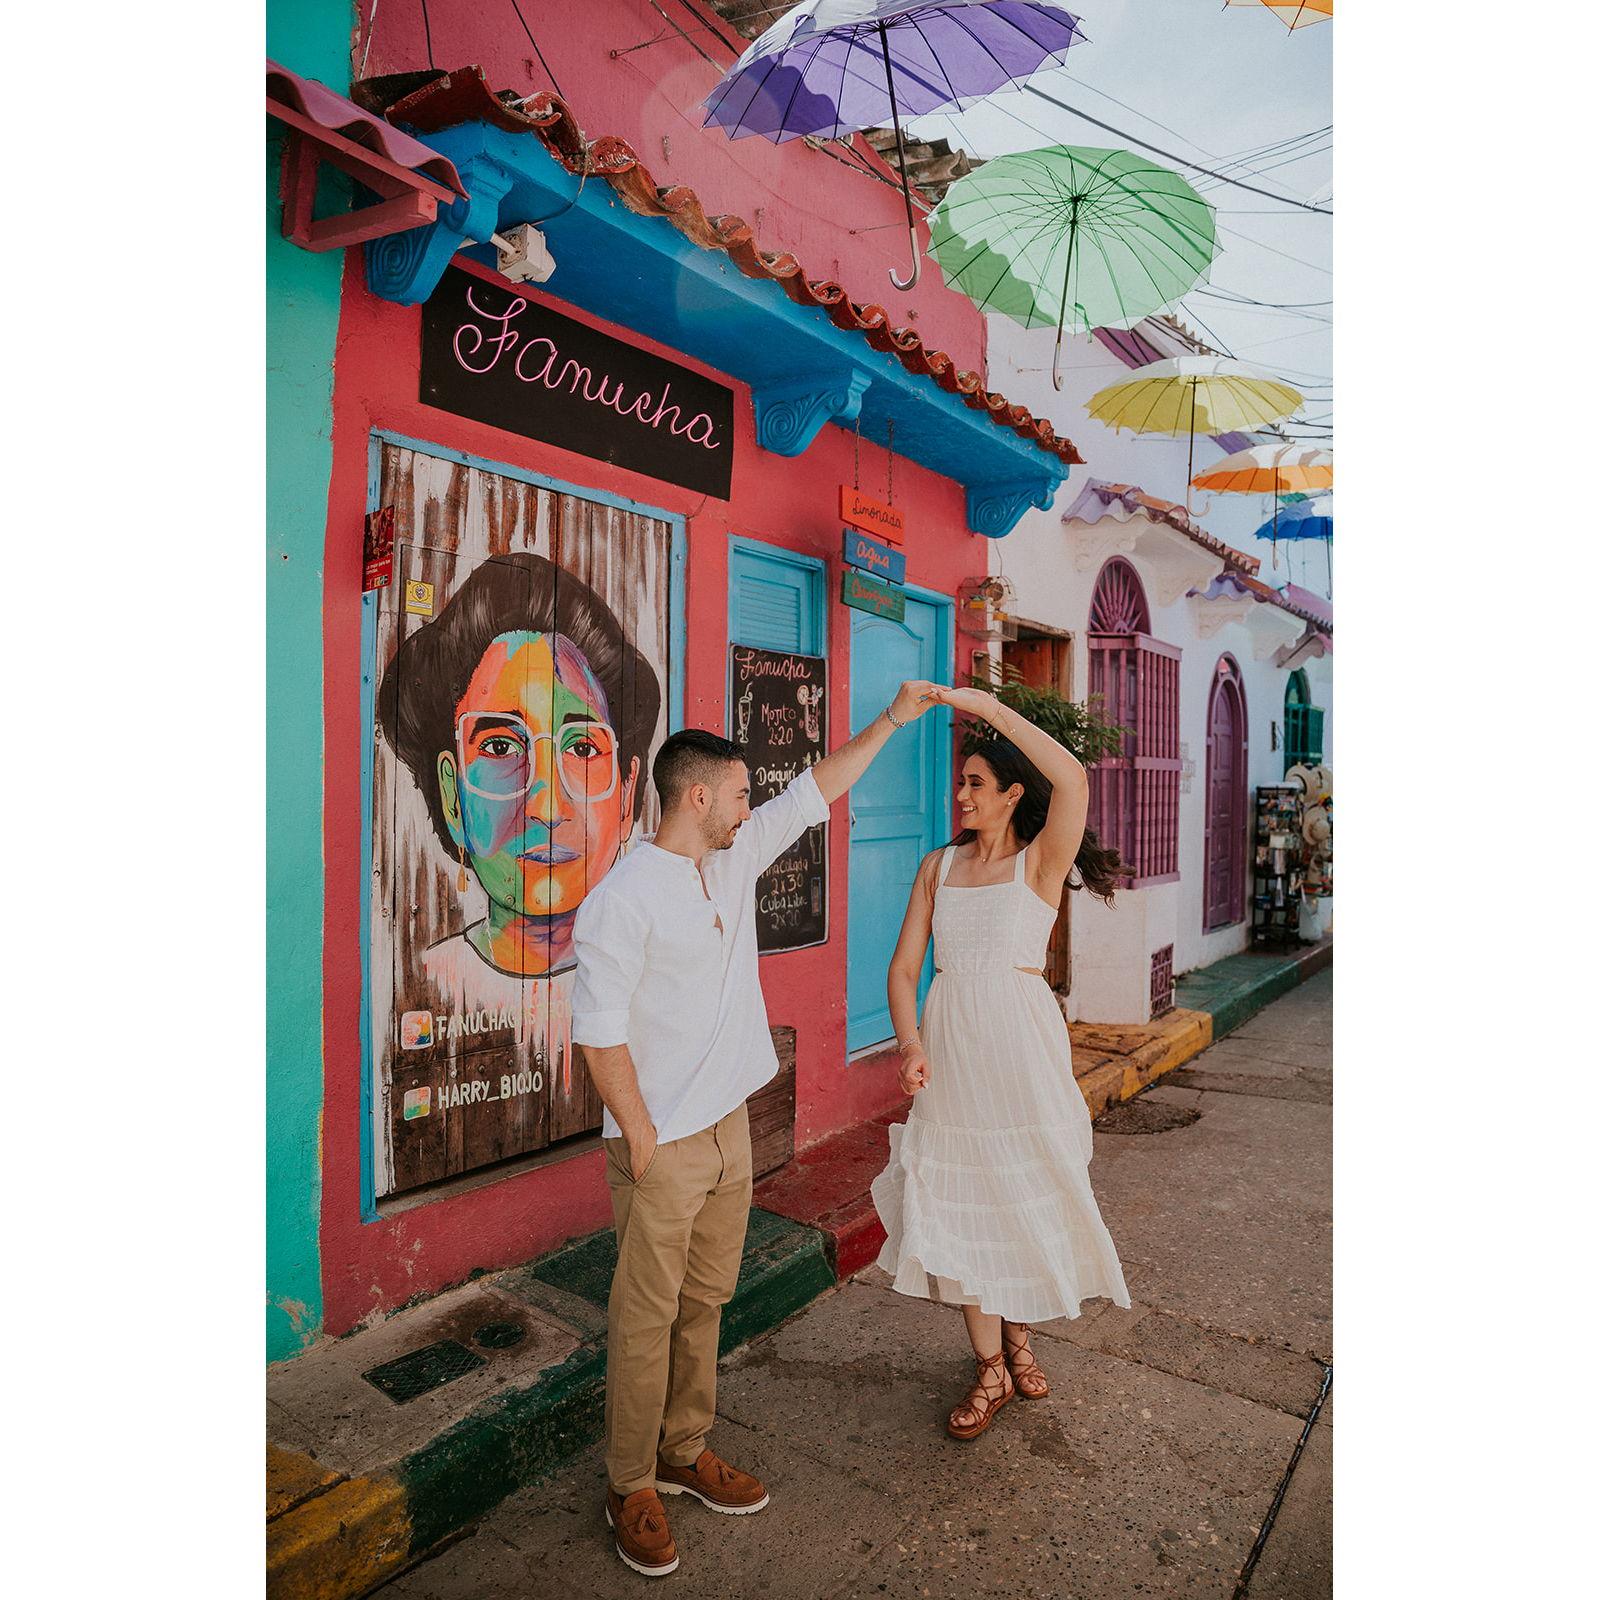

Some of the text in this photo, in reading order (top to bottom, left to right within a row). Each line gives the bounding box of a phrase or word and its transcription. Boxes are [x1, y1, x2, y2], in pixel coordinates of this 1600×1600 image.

[453, 286, 721, 449] Fanucha
[735, 650, 812, 682] Fanucha
[761, 703, 797, 727] Mojito
[760, 894, 787, 914] Cuba
